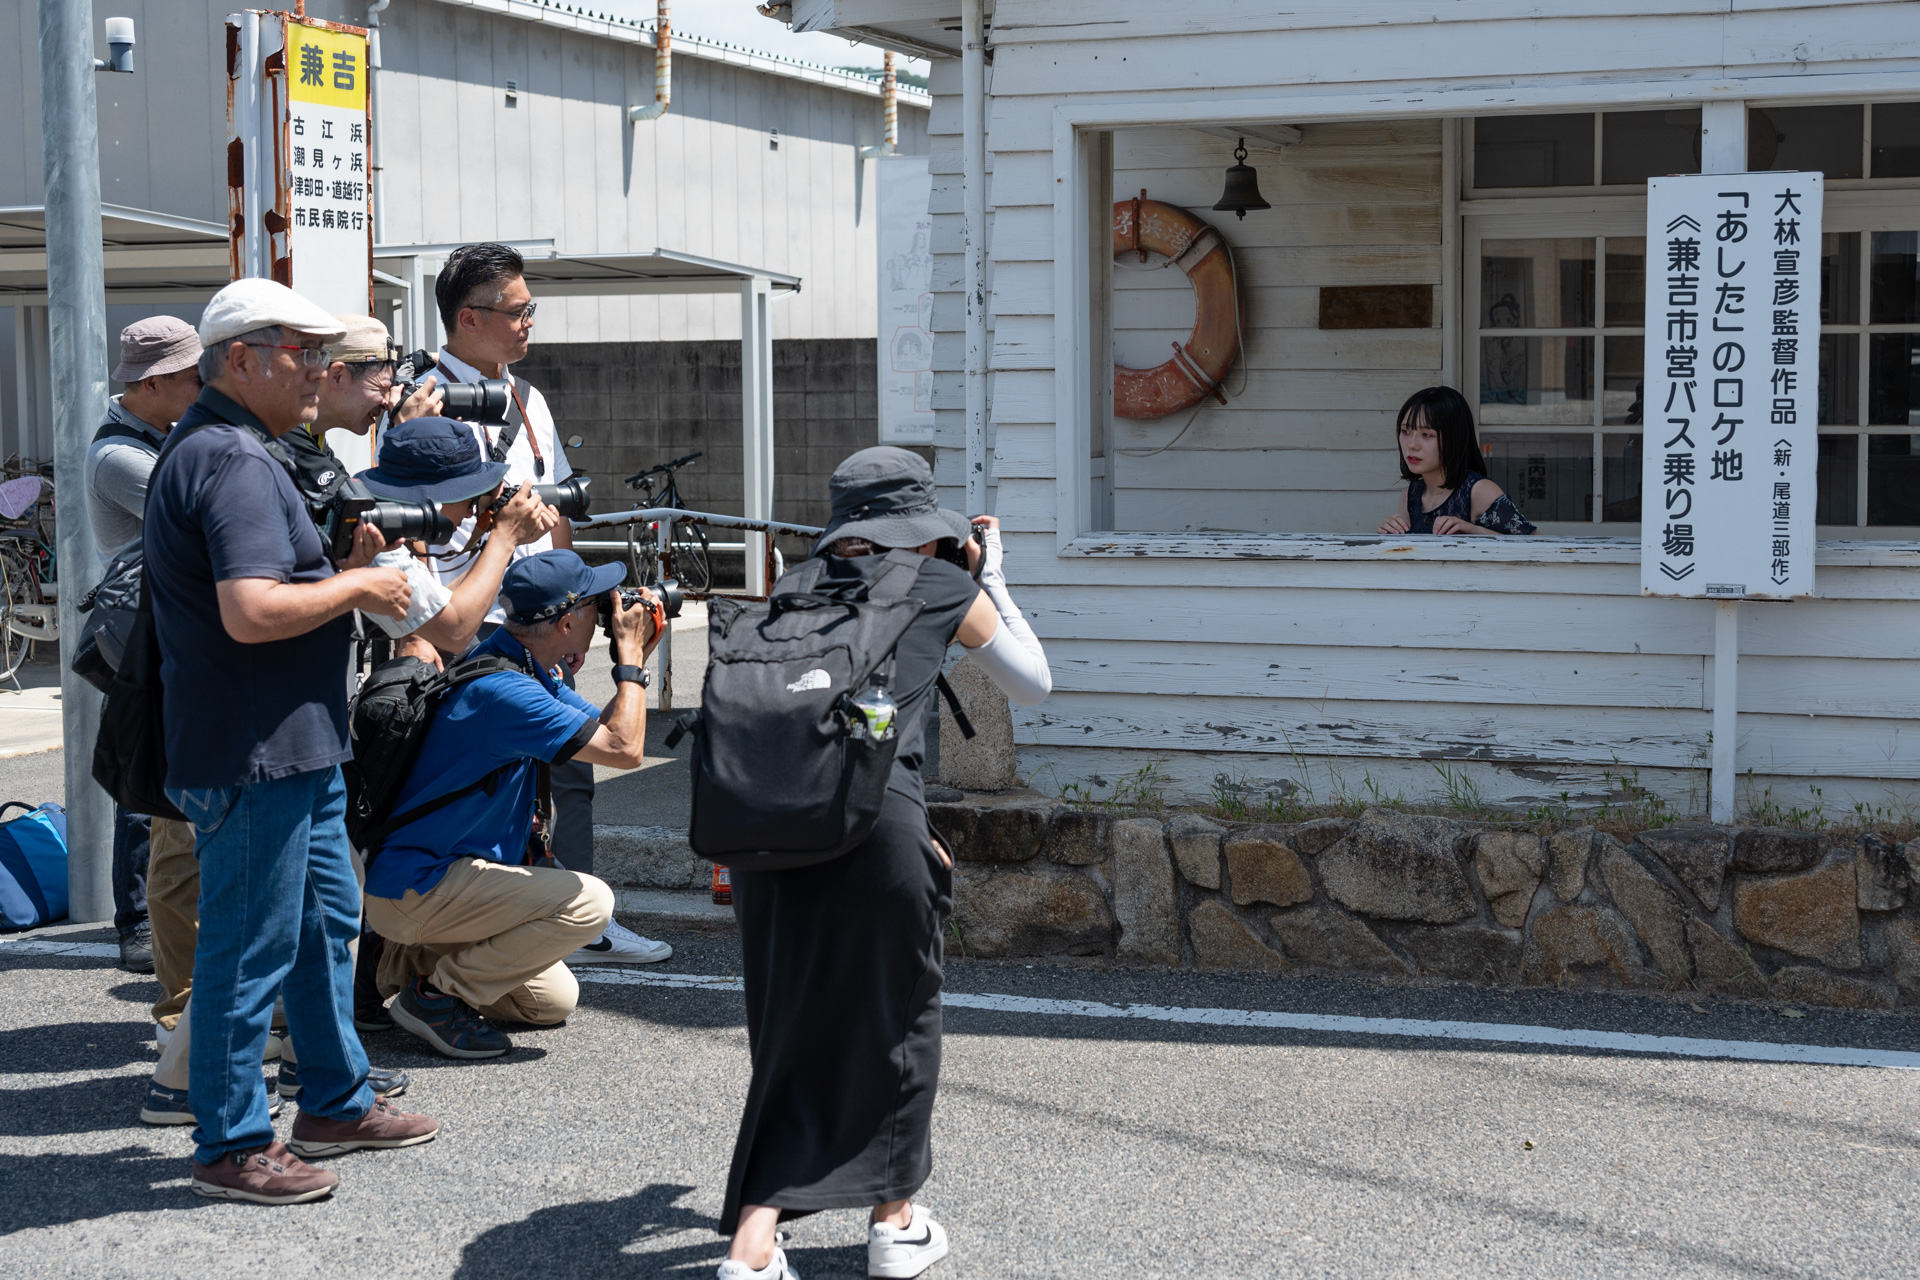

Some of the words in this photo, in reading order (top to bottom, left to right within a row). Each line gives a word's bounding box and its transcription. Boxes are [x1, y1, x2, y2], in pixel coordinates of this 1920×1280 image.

[300, 43, 356, 91] 兼吉
[293, 116, 363, 143] 古江浜
[294, 206, 364, 231] 市民病院行
[1770, 187, 1802, 425] 大林宣彦監督作品
[1709, 191, 1750, 481] 「あした」のロケ地
